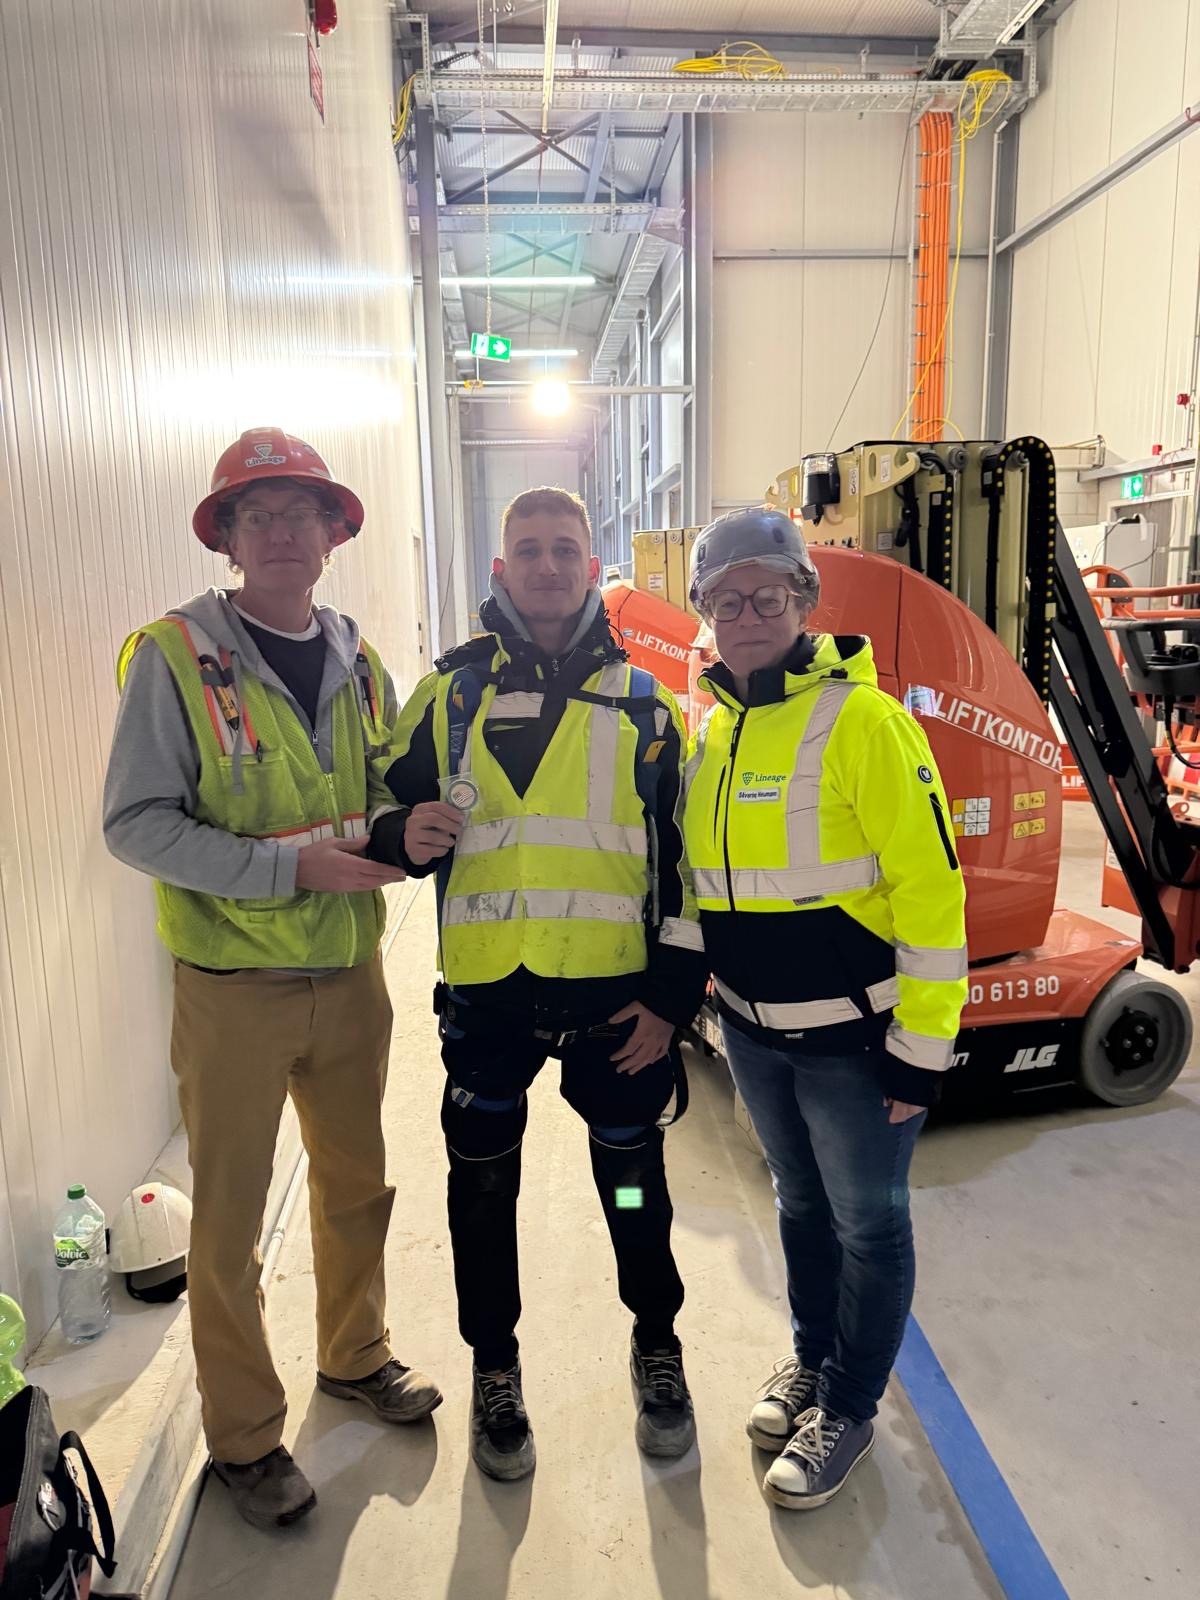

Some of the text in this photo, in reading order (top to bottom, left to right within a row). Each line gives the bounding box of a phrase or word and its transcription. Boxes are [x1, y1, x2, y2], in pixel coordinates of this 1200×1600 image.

[247, 457, 285, 466] Lineage
[755, 773, 787, 783] Lineage
[990, 979, 1029, 1002] 613
[1034, 975, 1060, 997] 80
[1004, 1044, 1060, 1073] JLG
